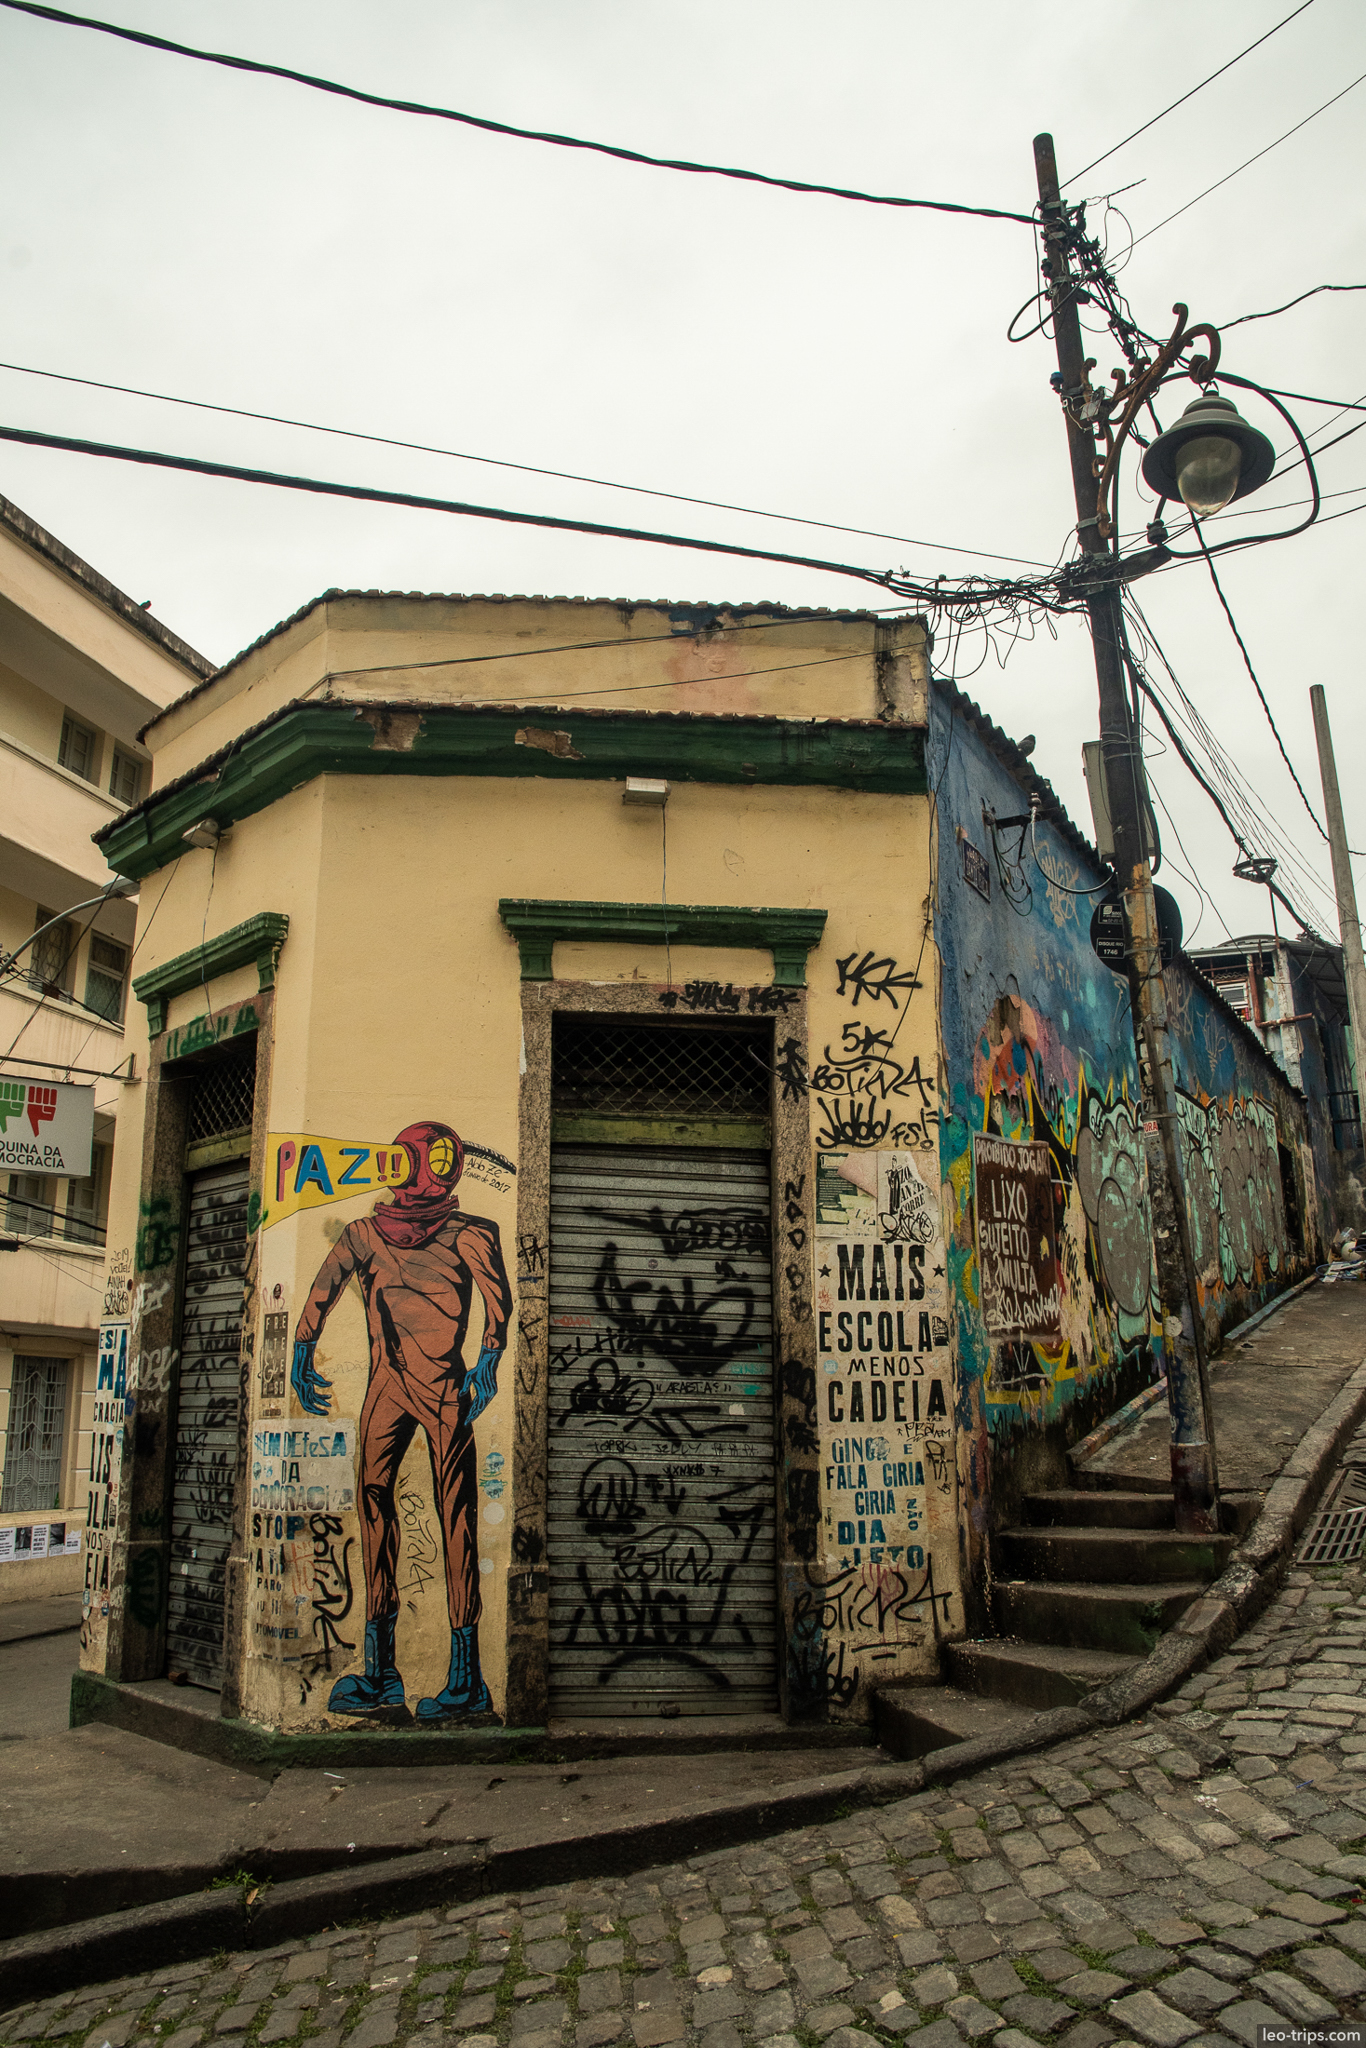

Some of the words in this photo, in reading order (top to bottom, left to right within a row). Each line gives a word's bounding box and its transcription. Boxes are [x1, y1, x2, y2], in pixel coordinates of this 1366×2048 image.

[43, 1145, 62, 1157] DA
[975, 1139, 1016, 1169] PROIBIDO
[1017, 1148, 1049, 1176] JOGAR
[276, 1140, 402, 1202] PAZ!!
[489, 1179, 511, 1193] 2017
[979, 1219, 1030, 1261] SUJEITO
[837, 1244, 926, 1301] MAIS
[999, 1257, 1039, 1297] MULTA
[819, 1311, 933, 1353] ESCOLA
[847, 1356, 925, 1376] MENOS
[828, 1379, 947, 1423] CADEIA
[903, 1444, 913, 1454] E
[281, 1460, 300, 1484] DA
[826, 1464, 868, 1490] FALA
[882, 1461, 925, 1487] GIRIA
[855, 1489, 896, 1515] GIRIA
[906, 1498, 922, 1531] NÃO
[253, 1513, 305, 1540] STOP
[838, 1519, 886, 1545] DIA
